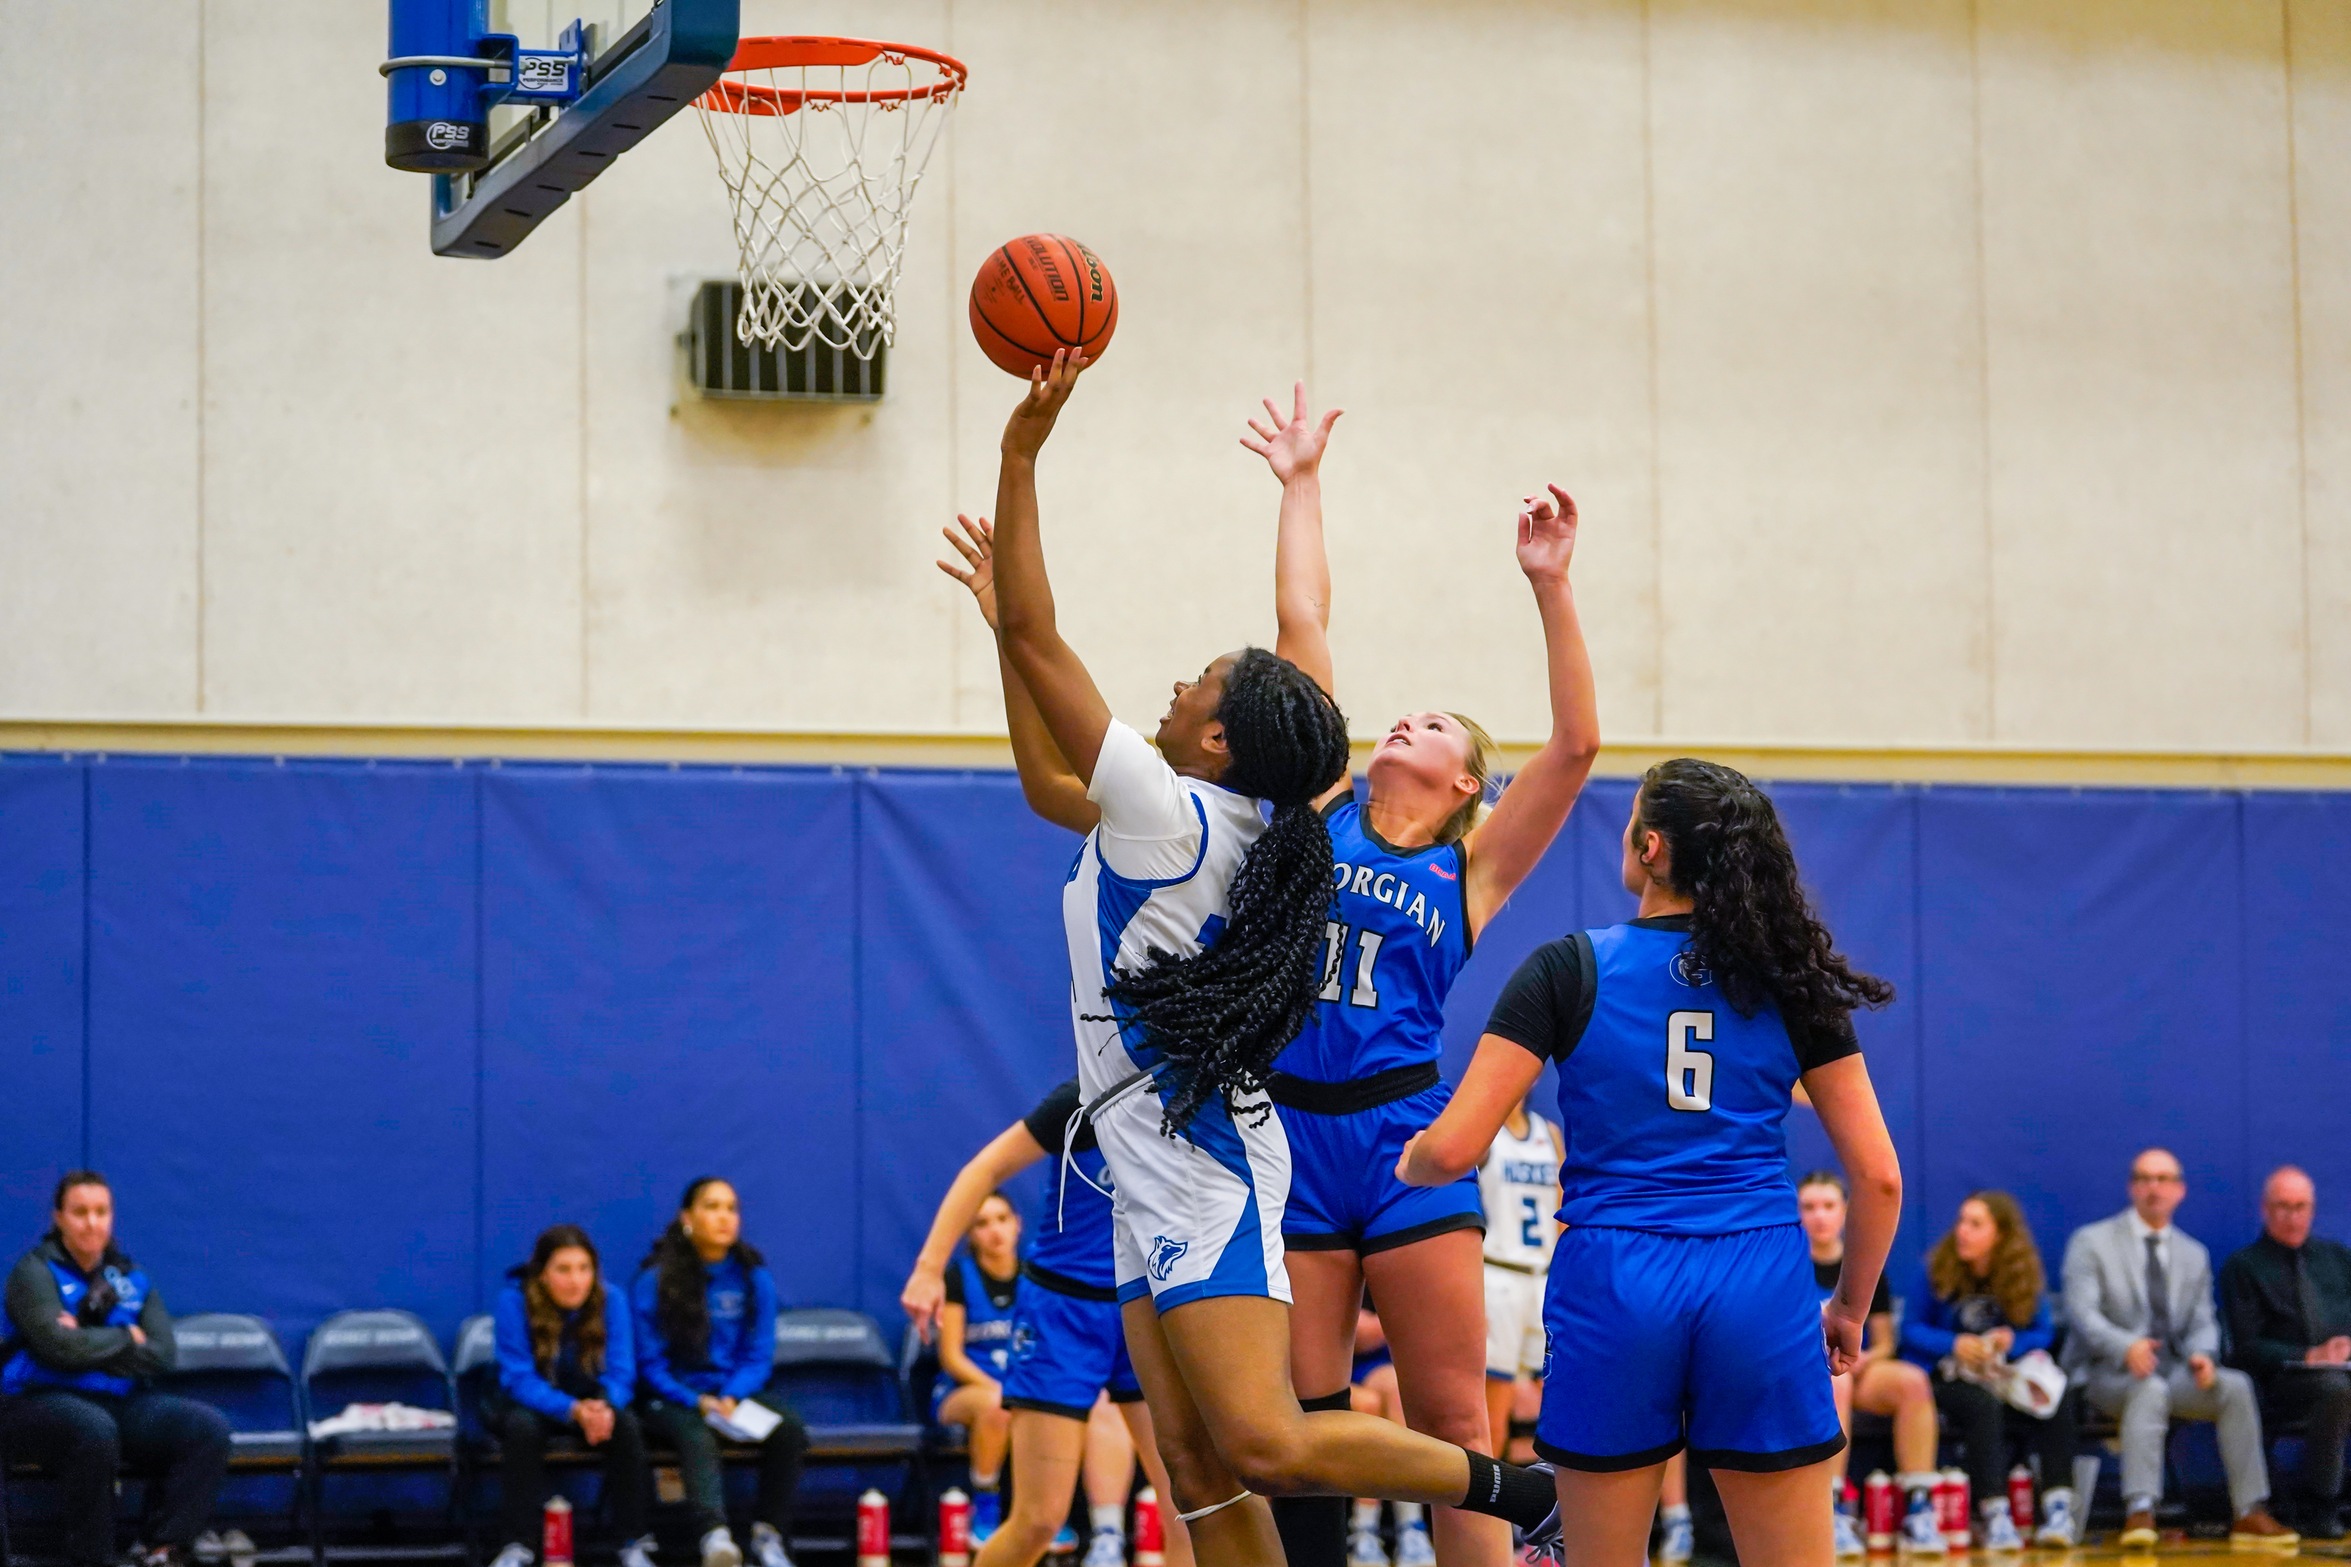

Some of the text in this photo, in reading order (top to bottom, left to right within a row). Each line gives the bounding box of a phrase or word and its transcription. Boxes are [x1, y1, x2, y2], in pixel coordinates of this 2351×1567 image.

[1022, 236, 1070, 302] VOLUTION
[1333, 862, 1447, 949] ORGIAN
[1317, 920, 1385, 1009] 11
[1667, 1010, 1714, 1112] 6
[1521, 1196, 1543, 1247] 2
